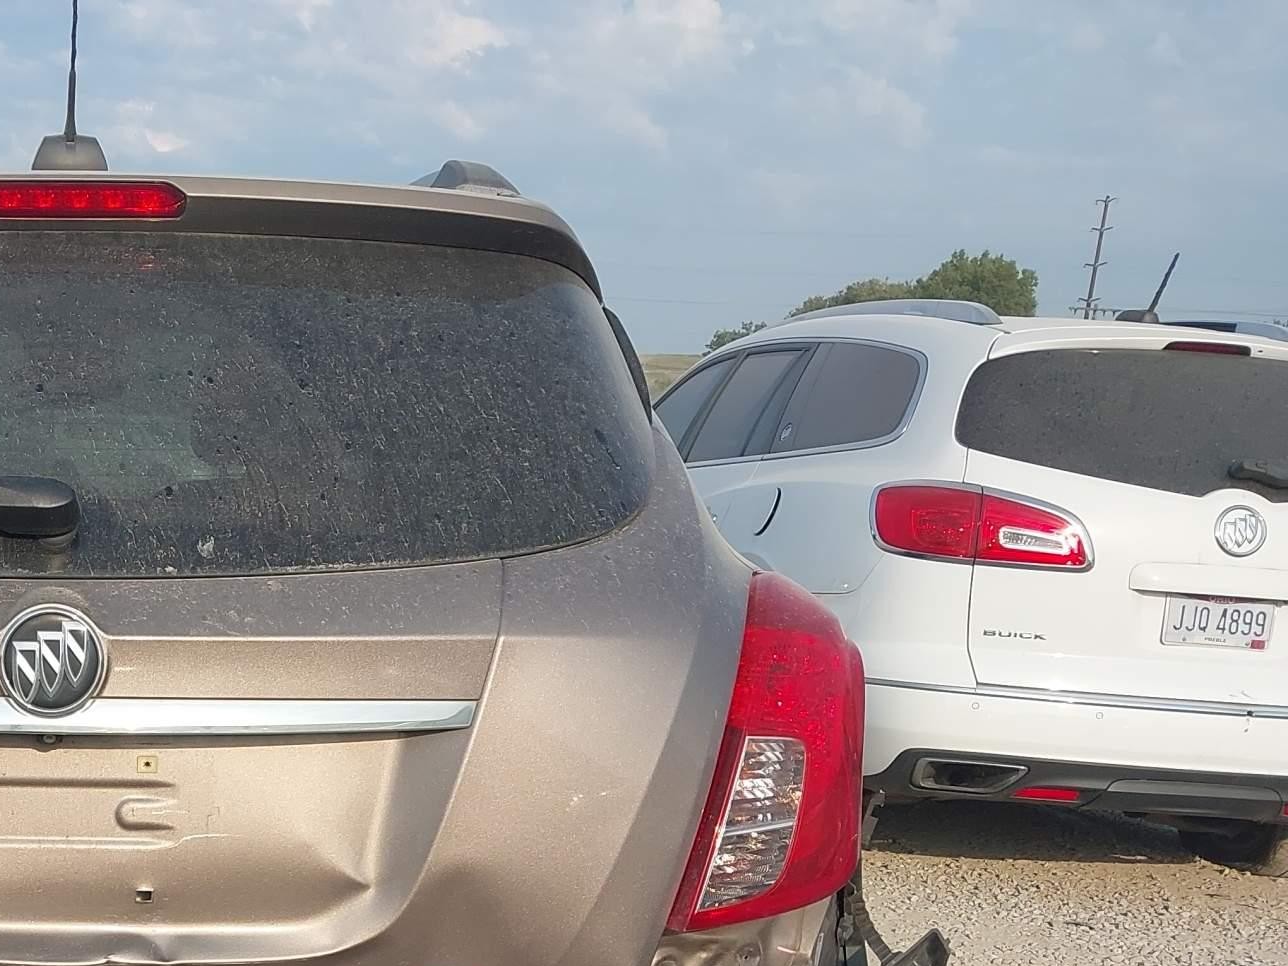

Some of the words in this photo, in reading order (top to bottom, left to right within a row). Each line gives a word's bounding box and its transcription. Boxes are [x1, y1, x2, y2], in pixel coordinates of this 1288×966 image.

[1173, 604, 1210, 632] JJQ
[1216, 608, 1267, 637] 4899
[983, 629, 1047, 641] BUICK
